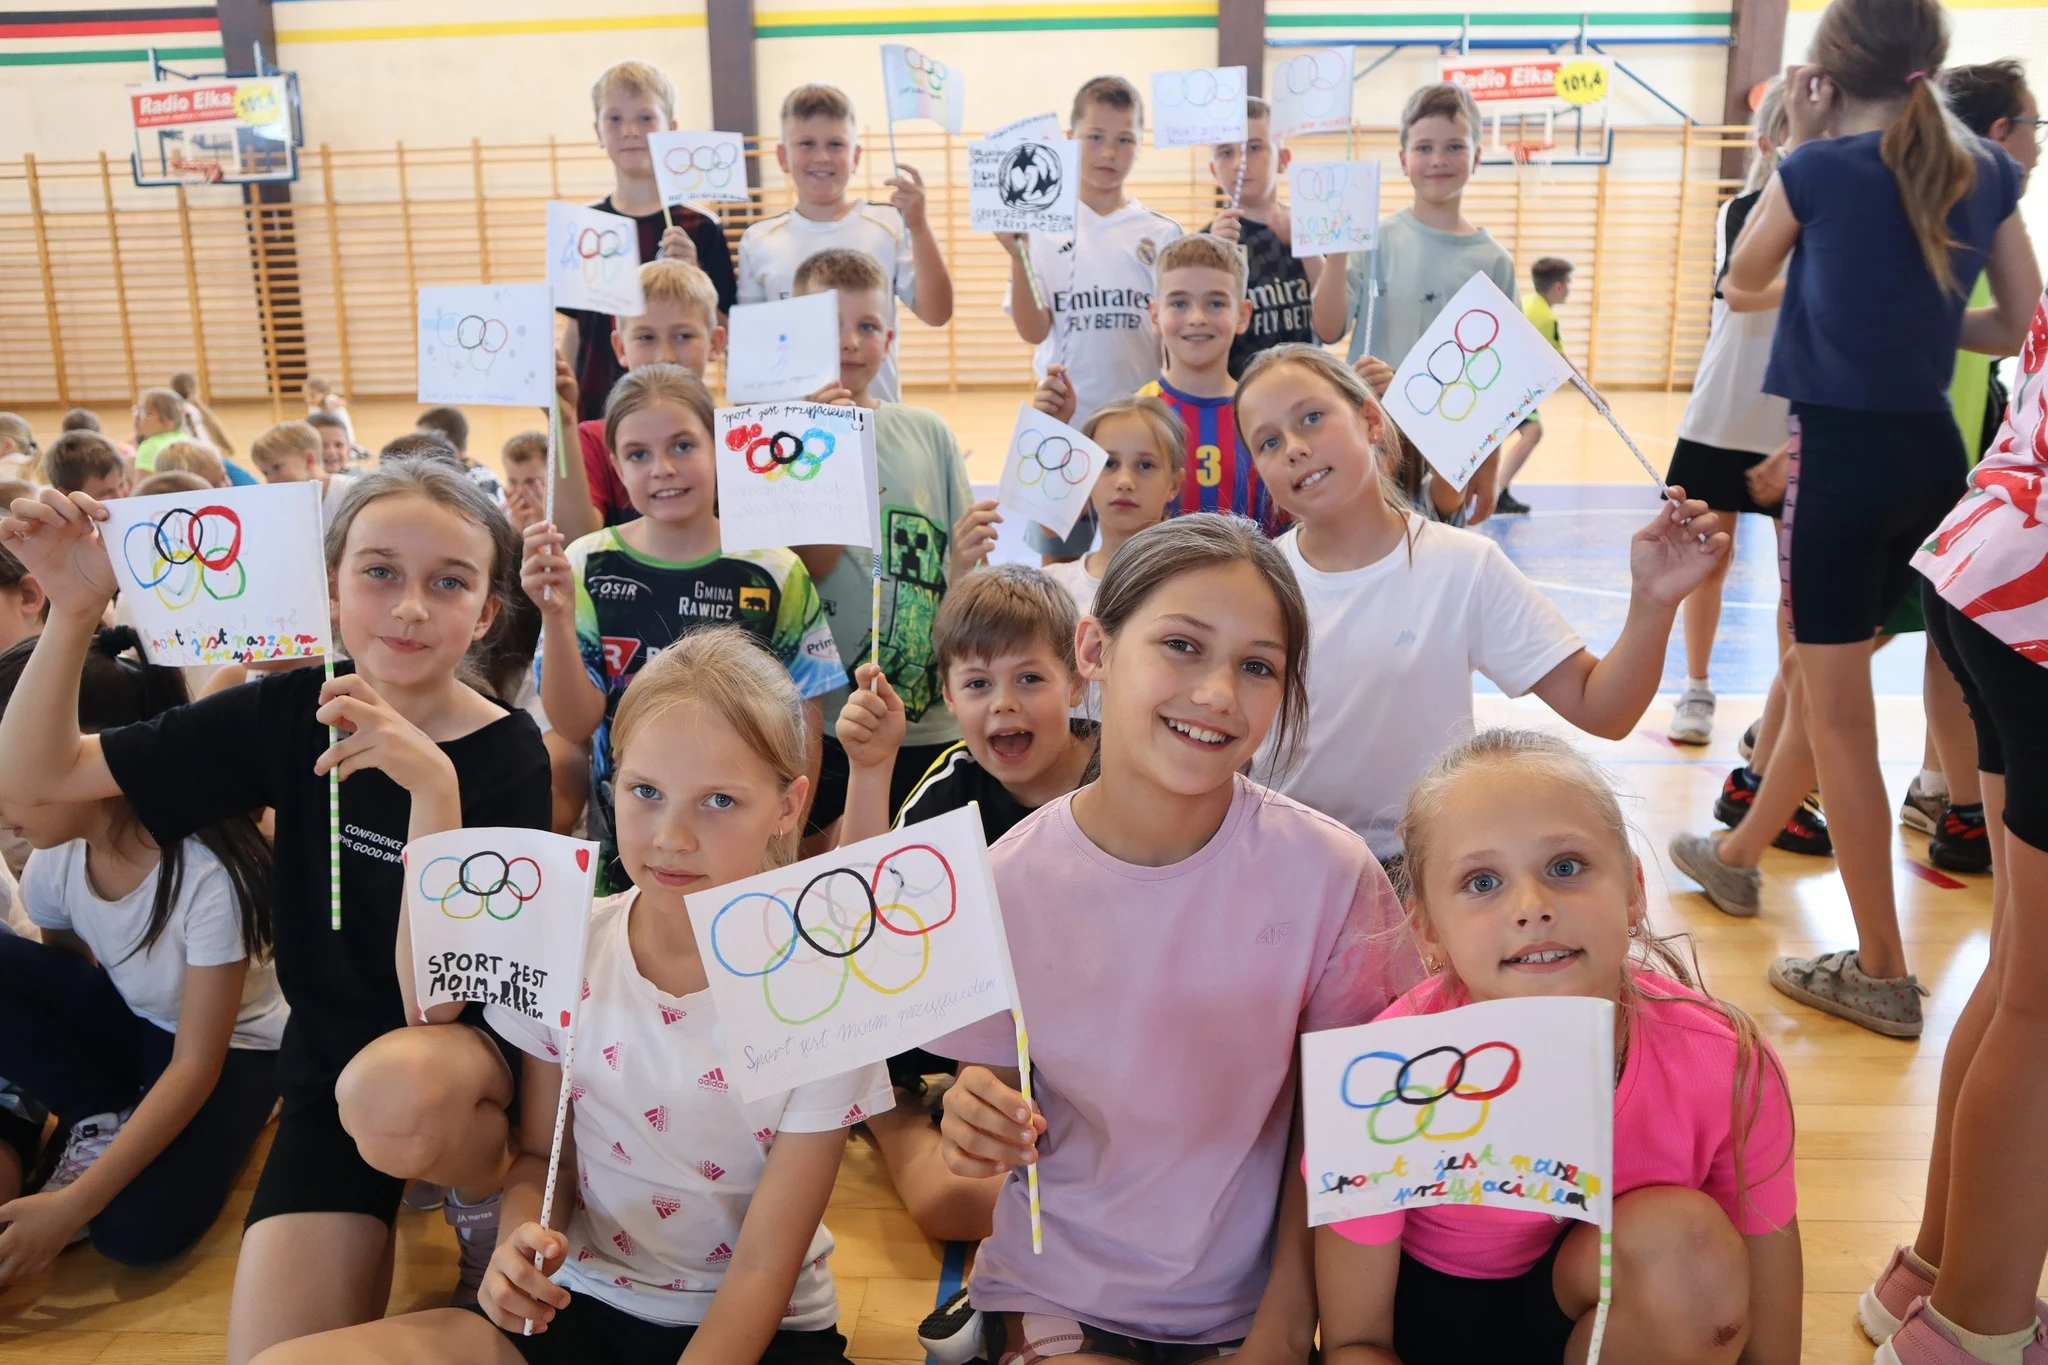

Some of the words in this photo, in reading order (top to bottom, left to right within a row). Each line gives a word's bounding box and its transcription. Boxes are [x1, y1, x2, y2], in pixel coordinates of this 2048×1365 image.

[1510, 66, 1554, 86] Elka
[1562, 73, 1602, 91] 101,4
[140, 94, 190, 115] Radio
[193, 89, 233, 110] Elka
[1053, 285, 1152, 312] Emirates
[1248, 277, 1310, 310] mira
[1254, 310, 1279, 336] FLY
[1283, 304, 1312, 331] BET
[1196, 445, 1221, 487] 3
[600, 582, 638, 596] OSIR
[694, 580, 733, 602] GMINA
[678, 597, 733, 620] RAWICZ
[191, 628, 228, 656] jest
[806, 639, 835, 655] Prim
[344, 823, 404, 850] CONFIDENCE
[352, 842, 383, 859] GOOD
[428, 952, 503, 975] SPORT
[430, 973, 488, 997] MOIM
[743, 1034, 794, 1073] Sport
[798, 1029, 830, 1058] jest
[697, 1078, 729, 1090] adidas
[656, 1105, 665, 1132] adidas
[841, 1114, 867, 1126] adidas
[1318, 1154, 1408, 1195] Sport
[1433, 1143, 1500, 1181] jest
[652, 1199, 681, 1209] adidas
[705, 1253, 732, 1262] adida
